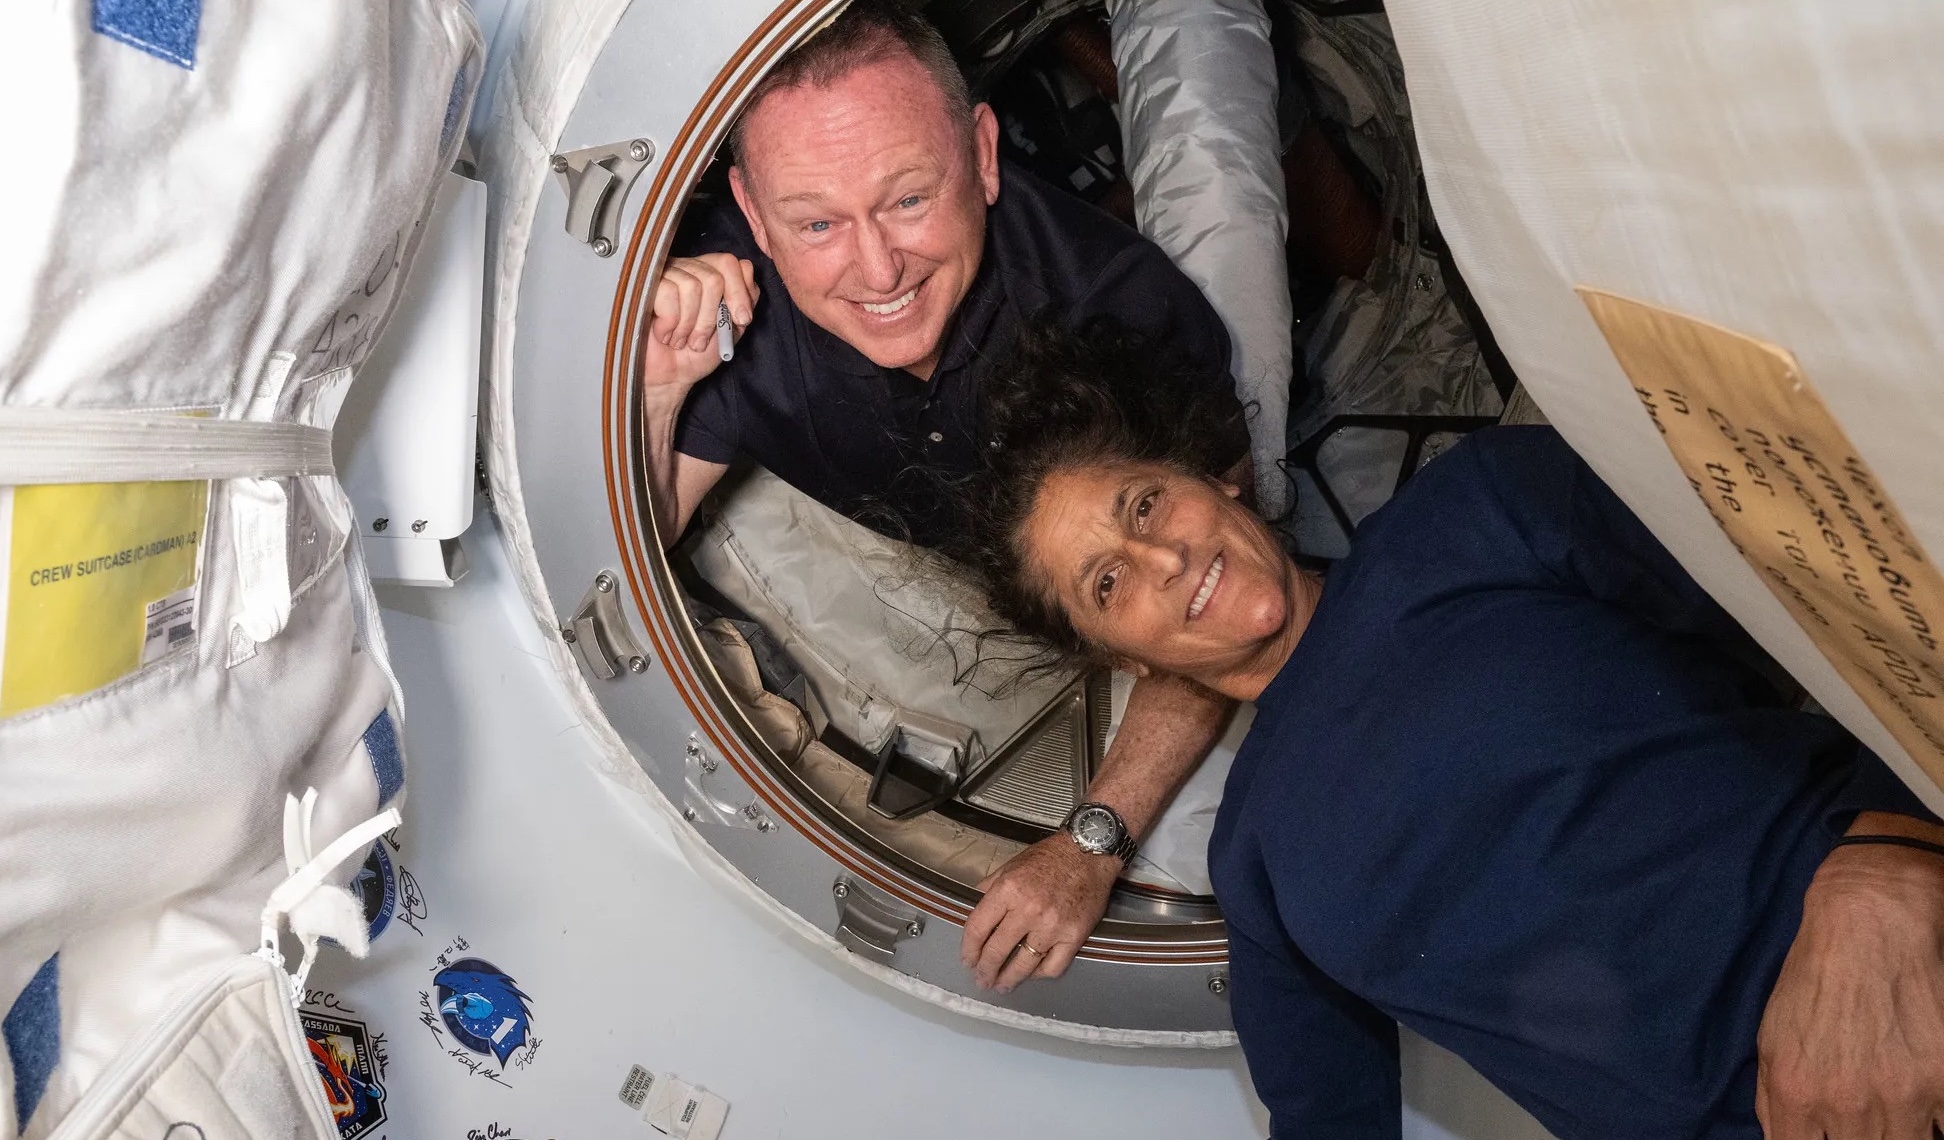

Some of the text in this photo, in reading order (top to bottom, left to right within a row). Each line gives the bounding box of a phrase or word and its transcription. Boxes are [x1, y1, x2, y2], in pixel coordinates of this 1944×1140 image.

[1664, 388, 1691, 416] in
[1705, 462, 1742, 513] the
[30, 563, 74, 587] CREW
[76, 549, 132, 577] SUITCASE
[133, 537, 185, 565] (CARDMAN)
[382, 875, 394, 918] ФЕДЯЕВ
[621, 1067, 640, 1099] RESTRAINT
[626, 1071, 647, 1104] WATER LINE
[634, 1077, 653, 1105] FUEL CELL
[340, 1122, 363, 1140] KATA
